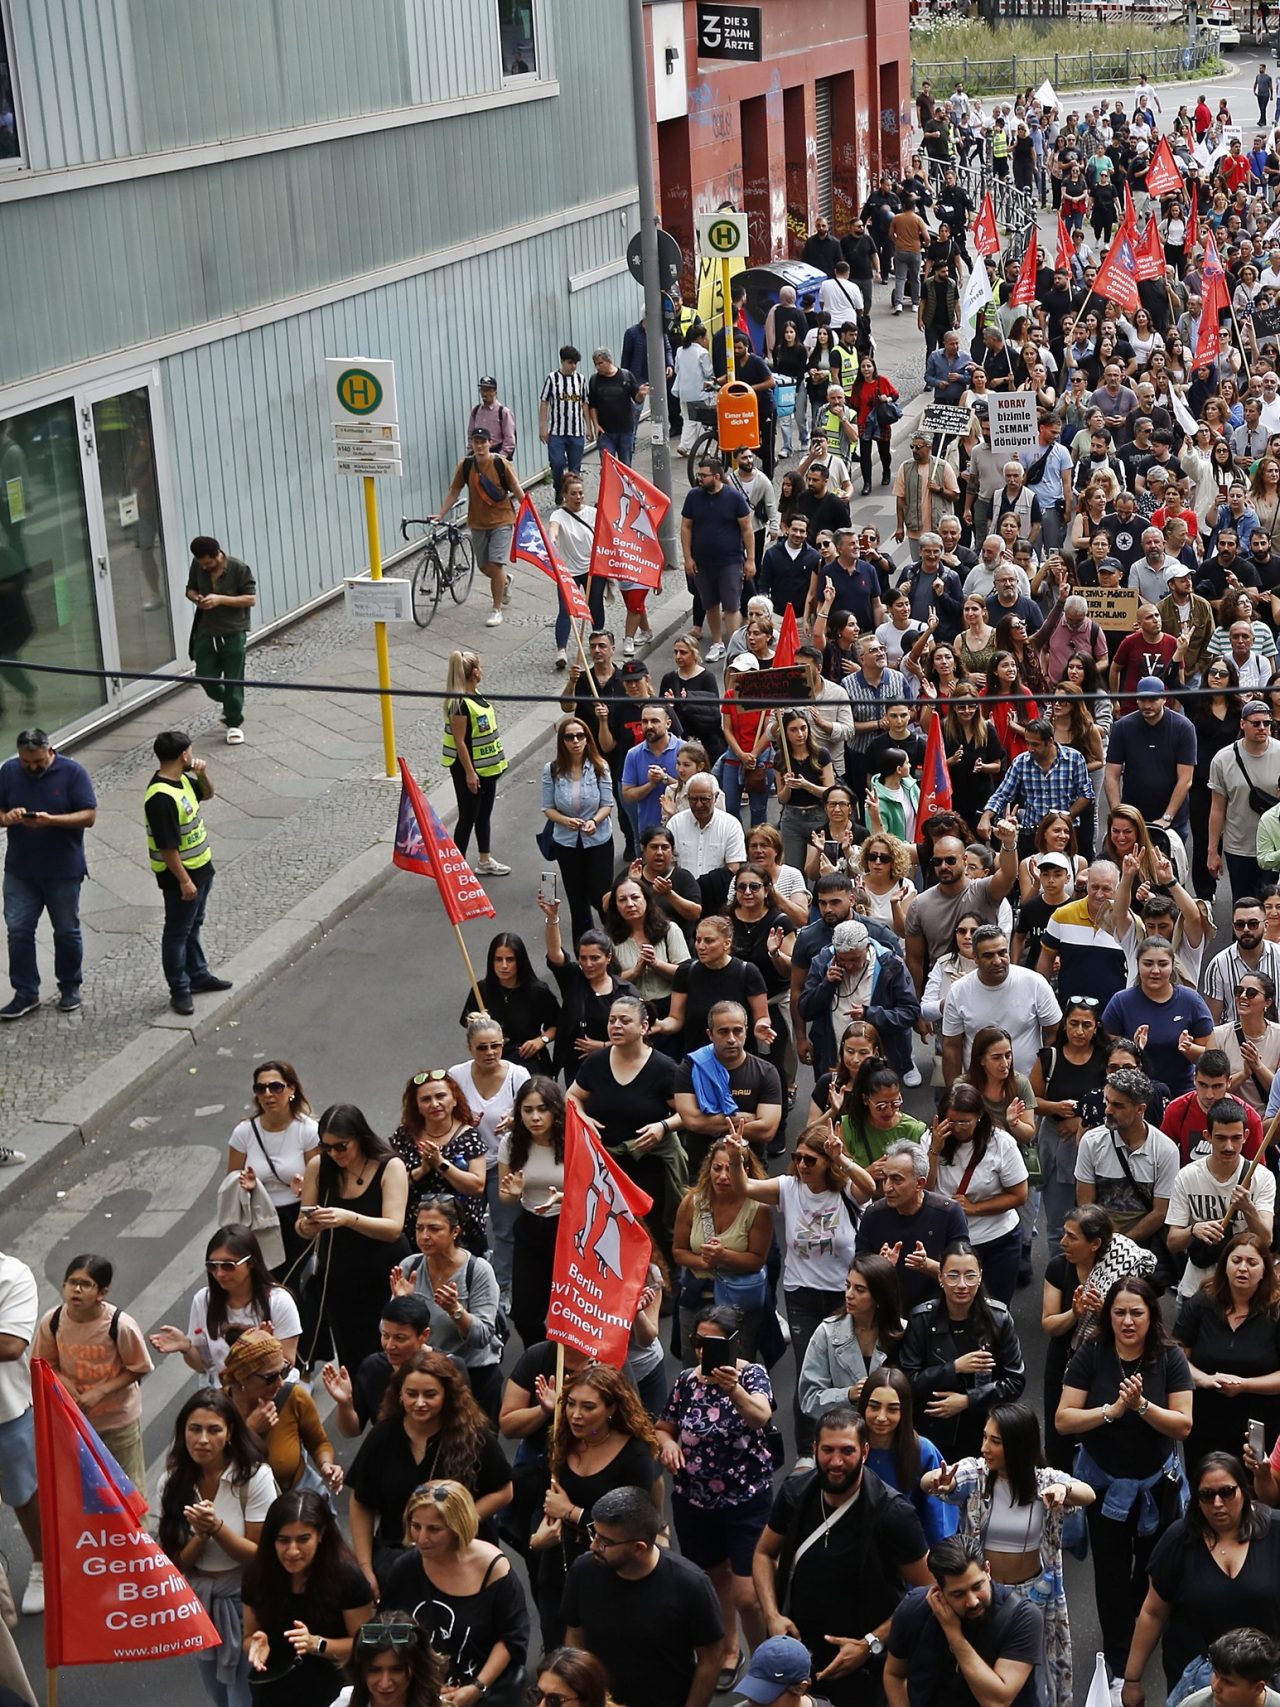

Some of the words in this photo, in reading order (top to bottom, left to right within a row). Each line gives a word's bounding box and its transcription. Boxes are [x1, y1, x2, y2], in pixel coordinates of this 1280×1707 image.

[724, 16, 740, 26] DIE
[742, 18, 748, 27] 3
[724, 28, 750, 39] ZAHN
[724, 38, 754, 50] ÄRZTE
[998, 399, 1026, 409] KORAY
[997, 412, 1031, 422] bizimle
[612, 536, 643, 553] Berlin
[608, 558, 643, 574] Cemevi
[618, 548, 661, 571] Toplumu
[1106, 600, 1115, 609] IN
[569, 1262, 603, 1300] Berlin
[572, 1287, 633, 1331] Toplumu
[551, 1301, 604, 1340] Cemevi
[548, 1327, 598, 1356] www.alevi.org
[118, 1573, 186, 1602] Berlin
[105, 1596, 202, 1631] Cemevi
[112, 1633, 204, 1658] www.alevi.org
